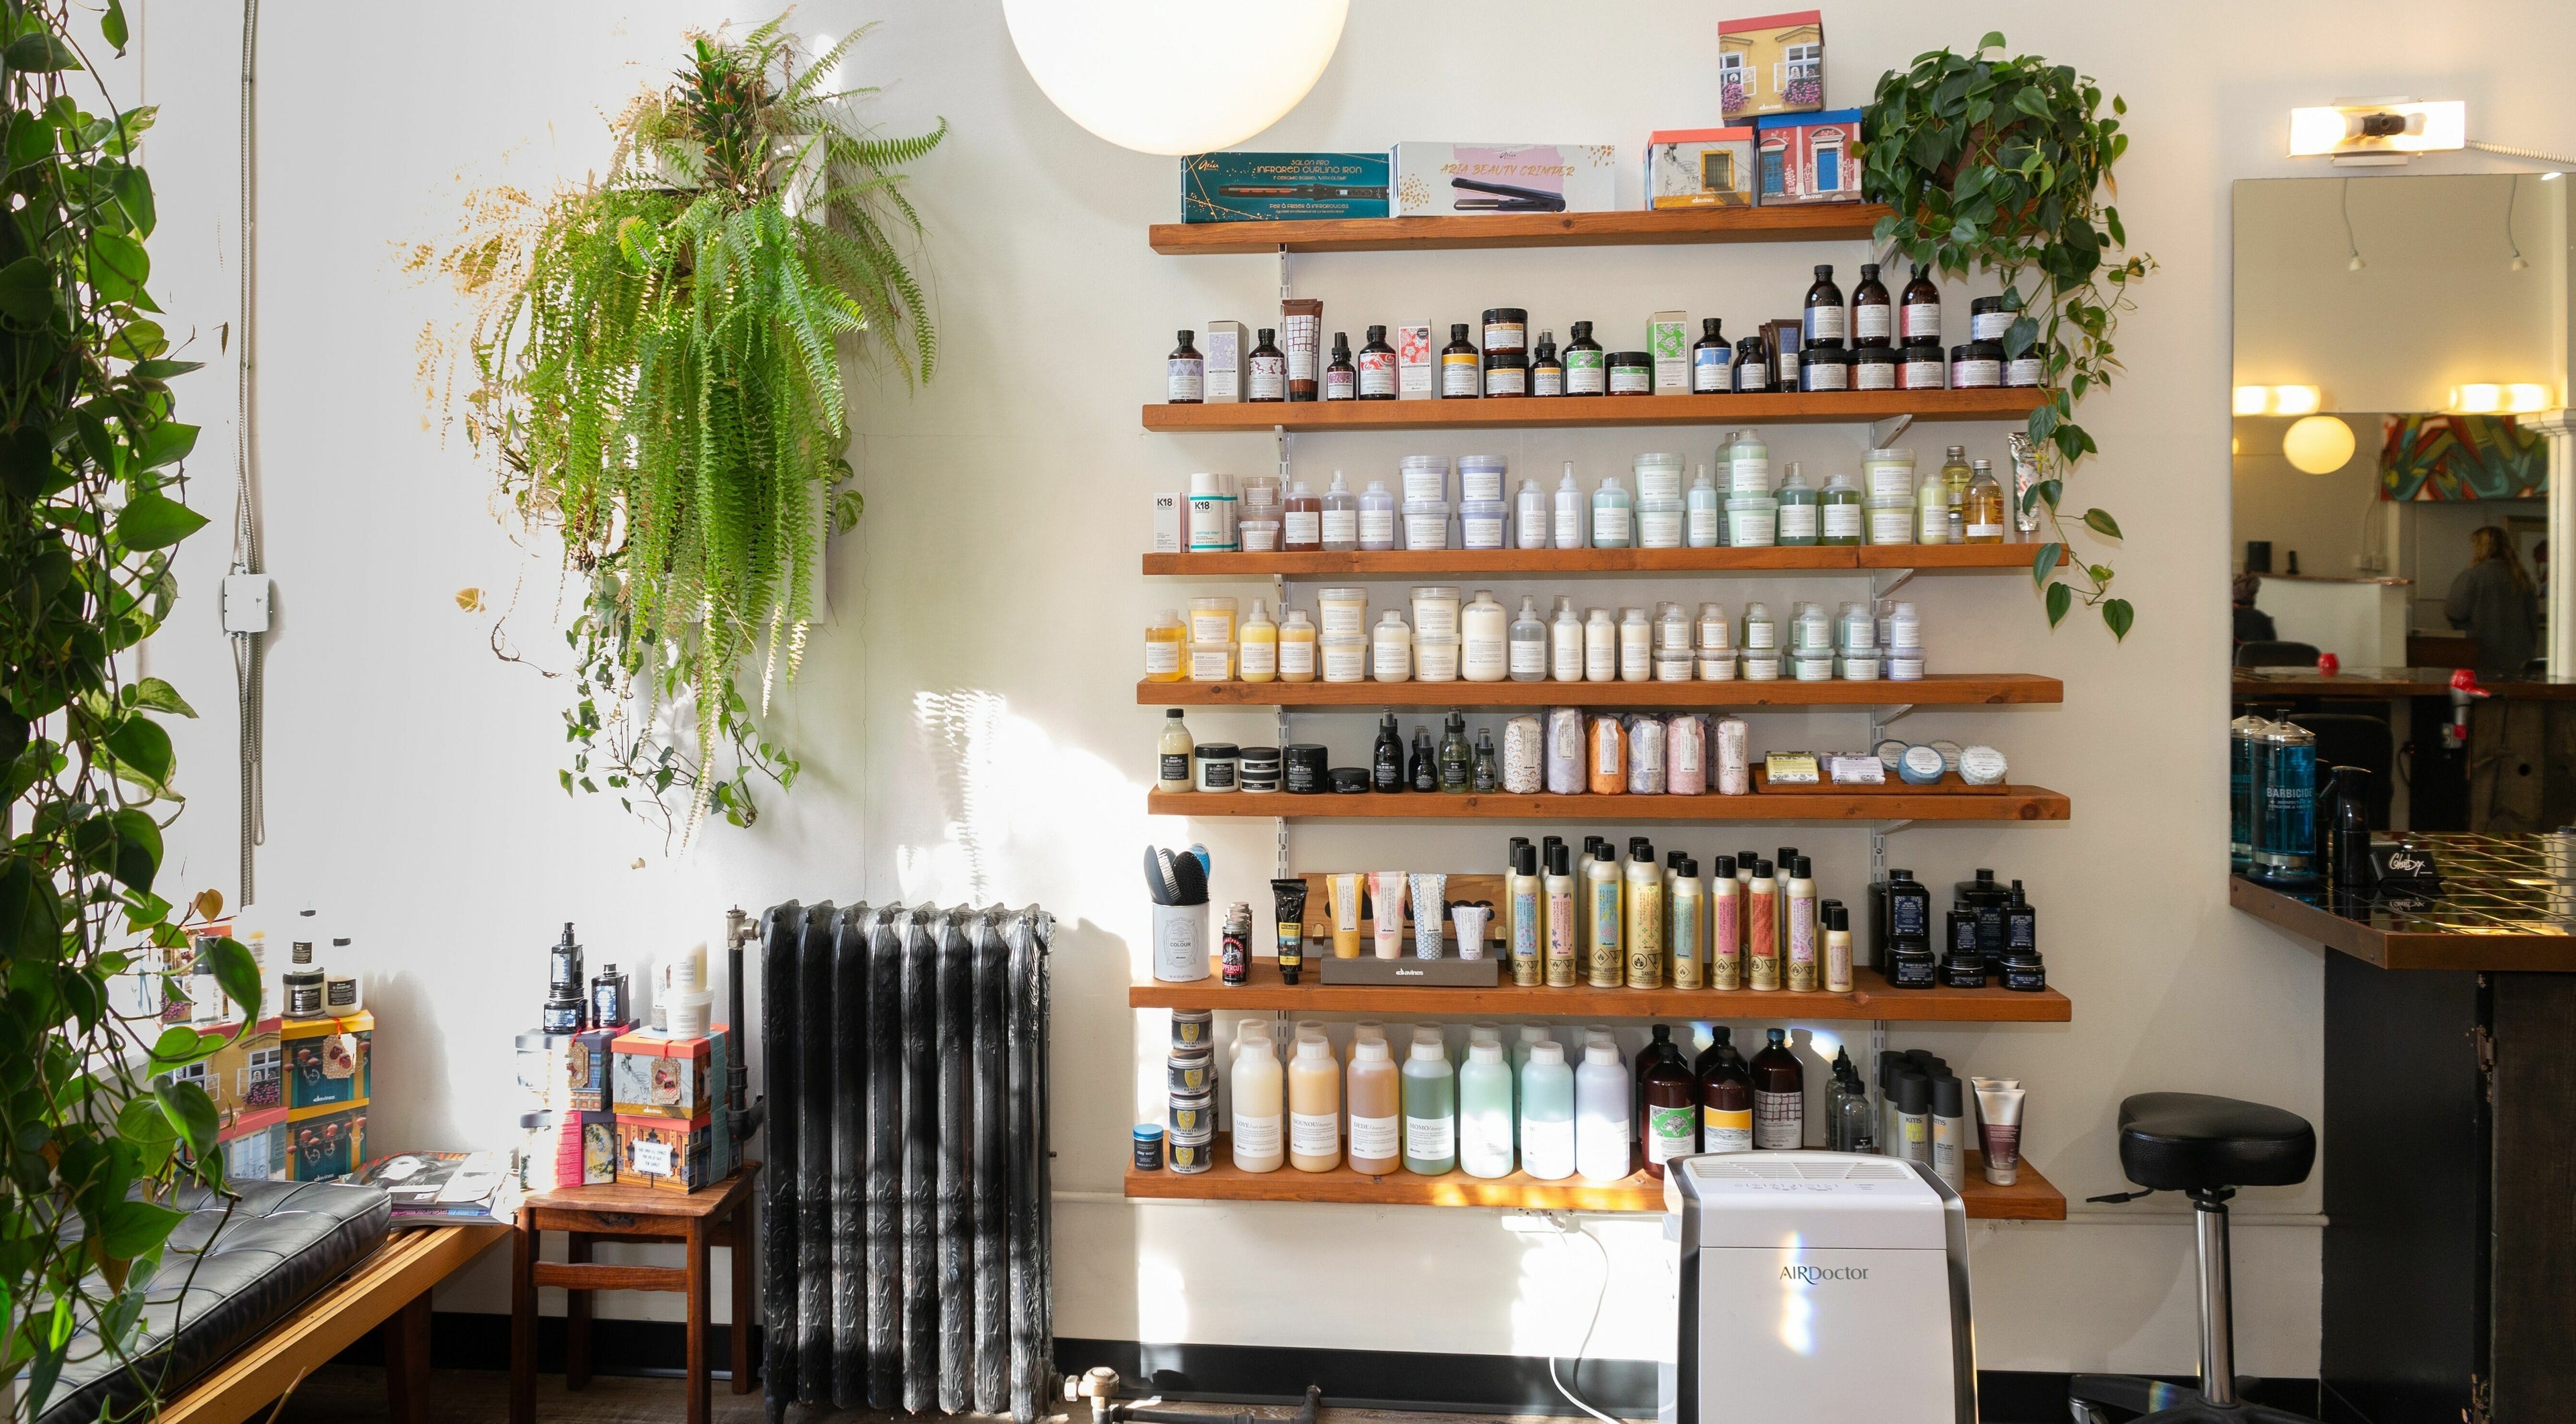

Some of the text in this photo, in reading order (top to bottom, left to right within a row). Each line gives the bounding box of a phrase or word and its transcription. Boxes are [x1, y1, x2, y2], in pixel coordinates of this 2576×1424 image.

[1440, 163, 1575, 177] ARIA BEAUTY CRIMPER
[1157, 498, 1173, 506] K18
[1195, 501, 1210, 510] K18
[2267, 787, 2312, 798] BARBICIDE
[1222, 964, 1243, 972] PPERCUT
[1395, 968, 1424, 976] davines
[643, 1106, 662, 1114] davines
[1906, 1123, 1922, 1132] HAIR
[314, 1174, 334, 1182] davines
